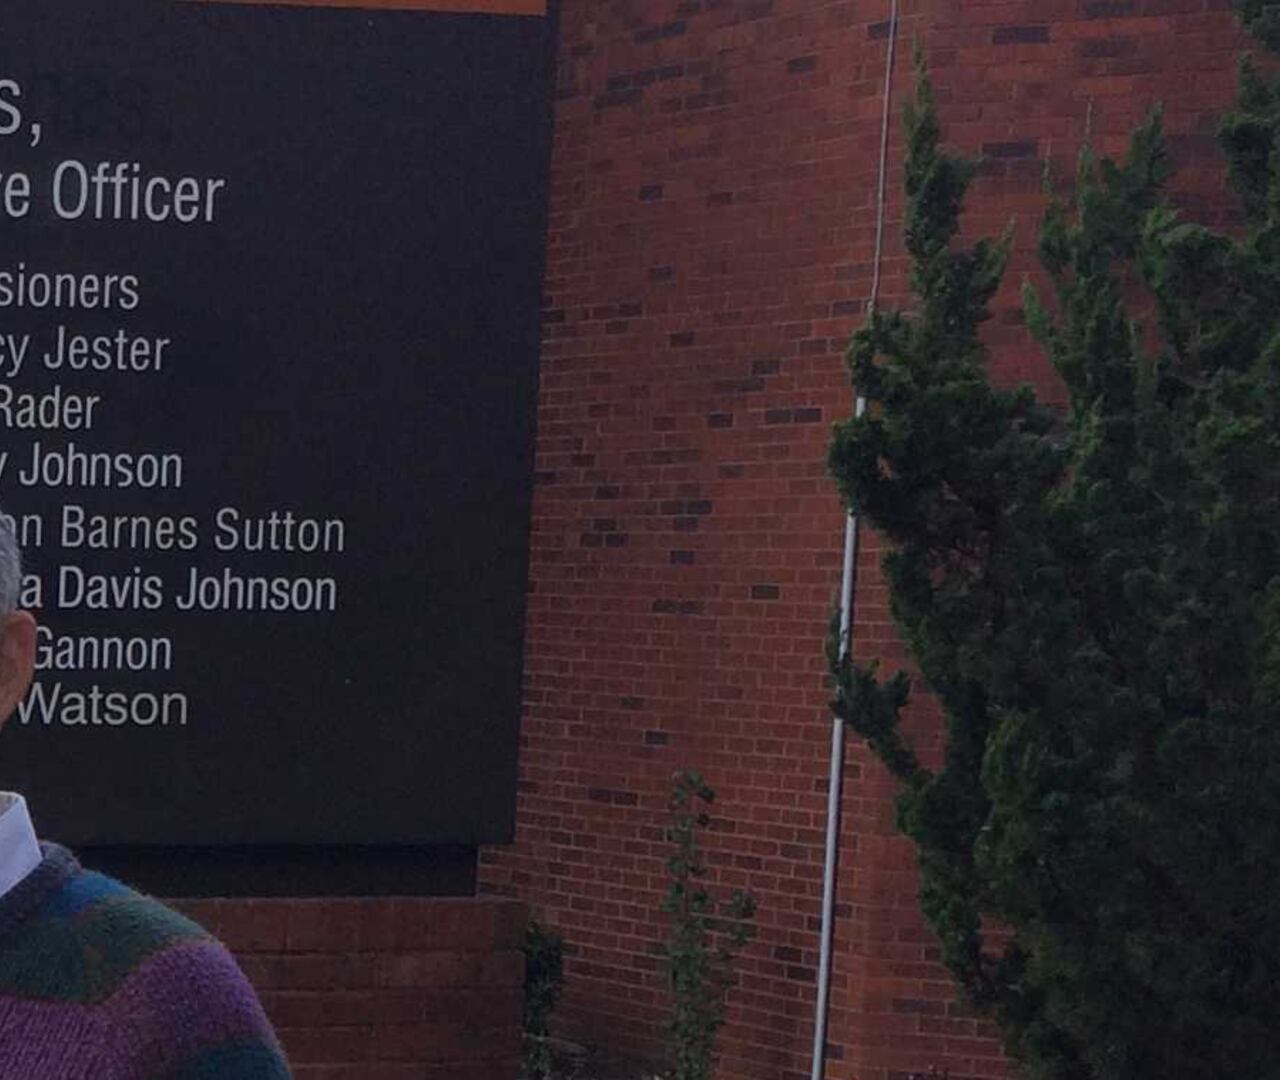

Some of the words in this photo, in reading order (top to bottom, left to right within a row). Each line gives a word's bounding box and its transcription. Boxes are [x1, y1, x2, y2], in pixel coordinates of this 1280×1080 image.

[54, 161, 224, 221] Officer
[44, 326, 169, 370] Jester
[20, 443, 181, 486] Johnson
[62, 506, 197, 549] Barnes
[216, 508, 343, 551] Sutton
[59, 566, 162, 608] Davis
[177, 568, 335, 610] Johnson
[33, 627, 170, 669] Gannon
[18, 682, 186, 724] Watson
